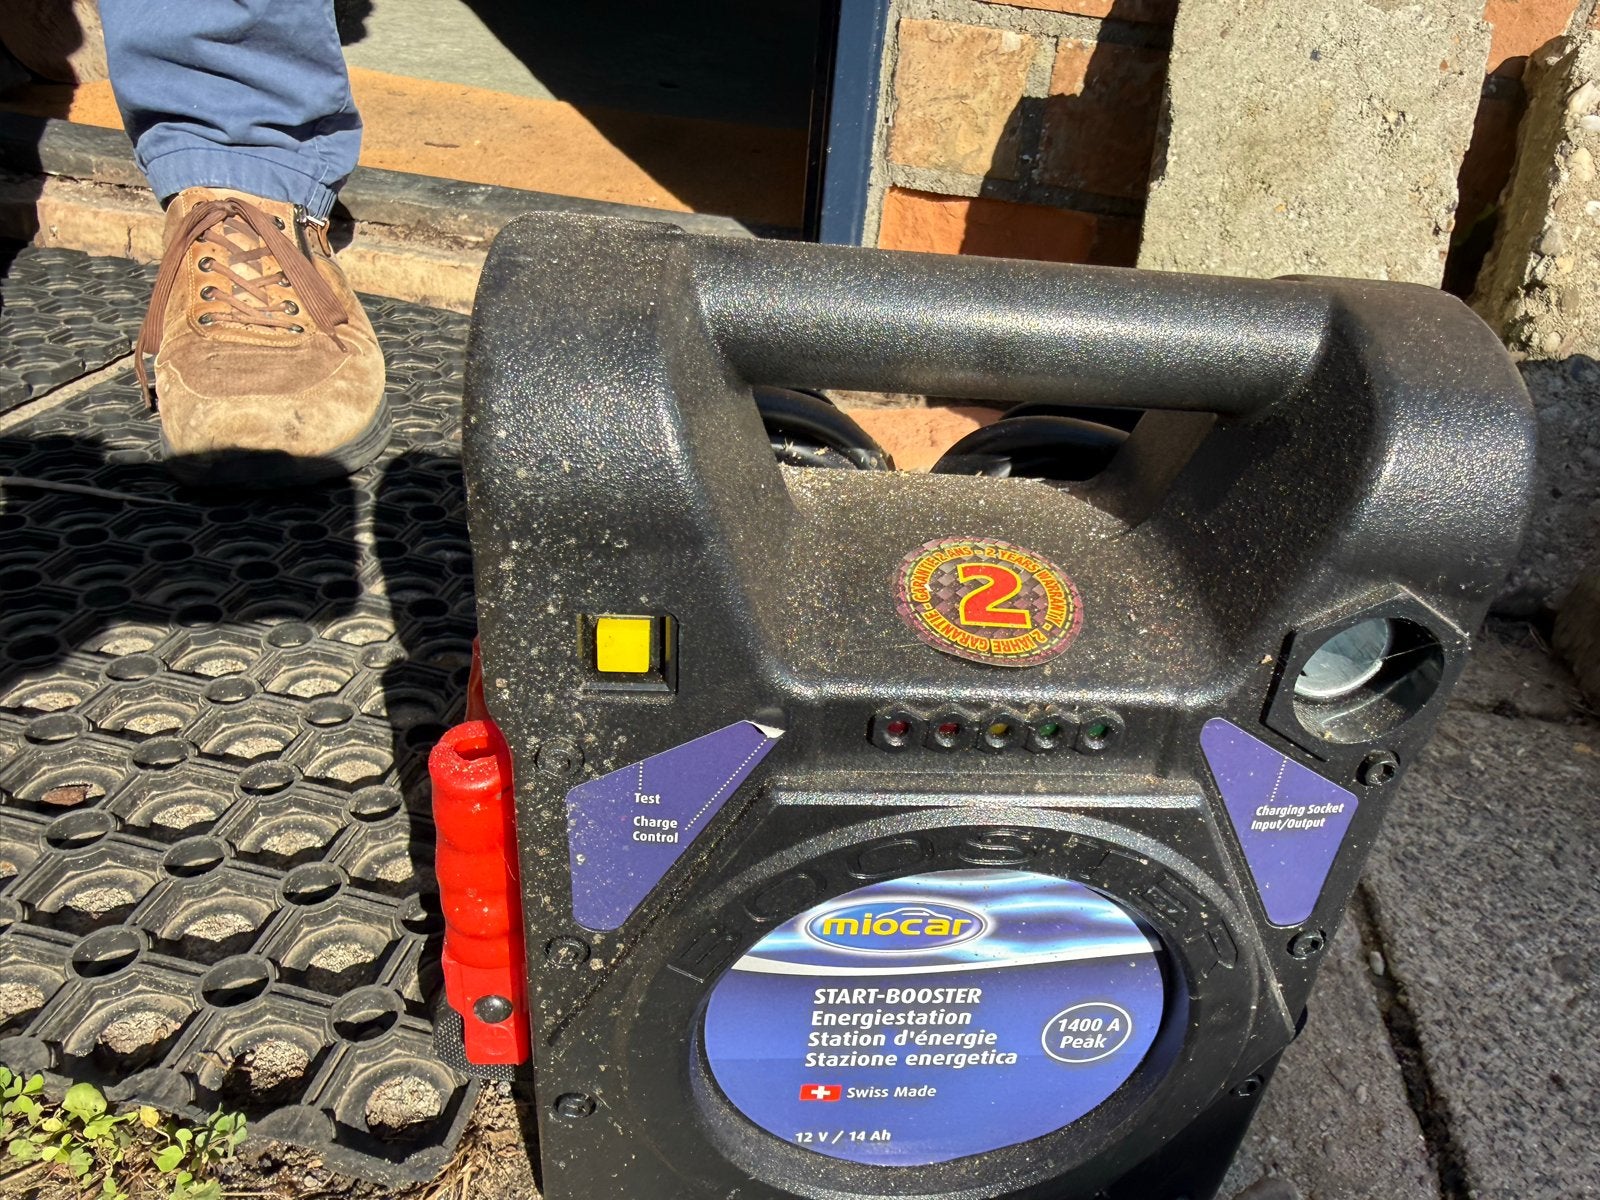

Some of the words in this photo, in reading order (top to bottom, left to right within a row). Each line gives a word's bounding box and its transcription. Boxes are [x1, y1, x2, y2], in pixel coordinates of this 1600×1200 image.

[945, 546, 974, 562] ANS
[985, 548, 996, 558] 2
[998, 549, 1041, 573] YEARS
[911, 557, 938, 602] GARANTIE
[957, 562, 1032, 629] 2
[1035, 569, 1067, 628] WARRANTY
[922, 609, 990, 651] GARANTIE
[1030, 628, 1048, 644] 2
[634, 792, 661, 805] Test
[1255, 805, 1305, 818] Charging
[1306, 803, 1345, 815] Socket
[633, 815, 678, 830] Charge
[1251, 818, 1326, 832] Input/Output
[632, 831, 679, 844] Control
[822, 912, 972, 937] miocar
[813, 987, 983, 1006] START-BOOSTER
[811, 1009, 972, 1029] Energiestation
[1057, 1017, 1103, 1034] 1400
[1107, 1017, 1121, 1033] A
[807, 1030, 886, 1048] Station
[893, 1029, 998, 1050] d'énergie
[1059, 1033, 1107, 1050] Peak
[804, 1049, 898, 1068] Stazione
[905, 1049, 1018, 1069] energetica
[847, 1086, 889, 1099] Swiss
[893, 1085, 937, 1098] Made
[795, 1132, 813, 1143] 12
[818, 1131, 829, 1143] V
[831, 1130, 844, 1144] /
[849, 1131, 866, 1142] 14
[870, 1129, 892, 1142] Ah
